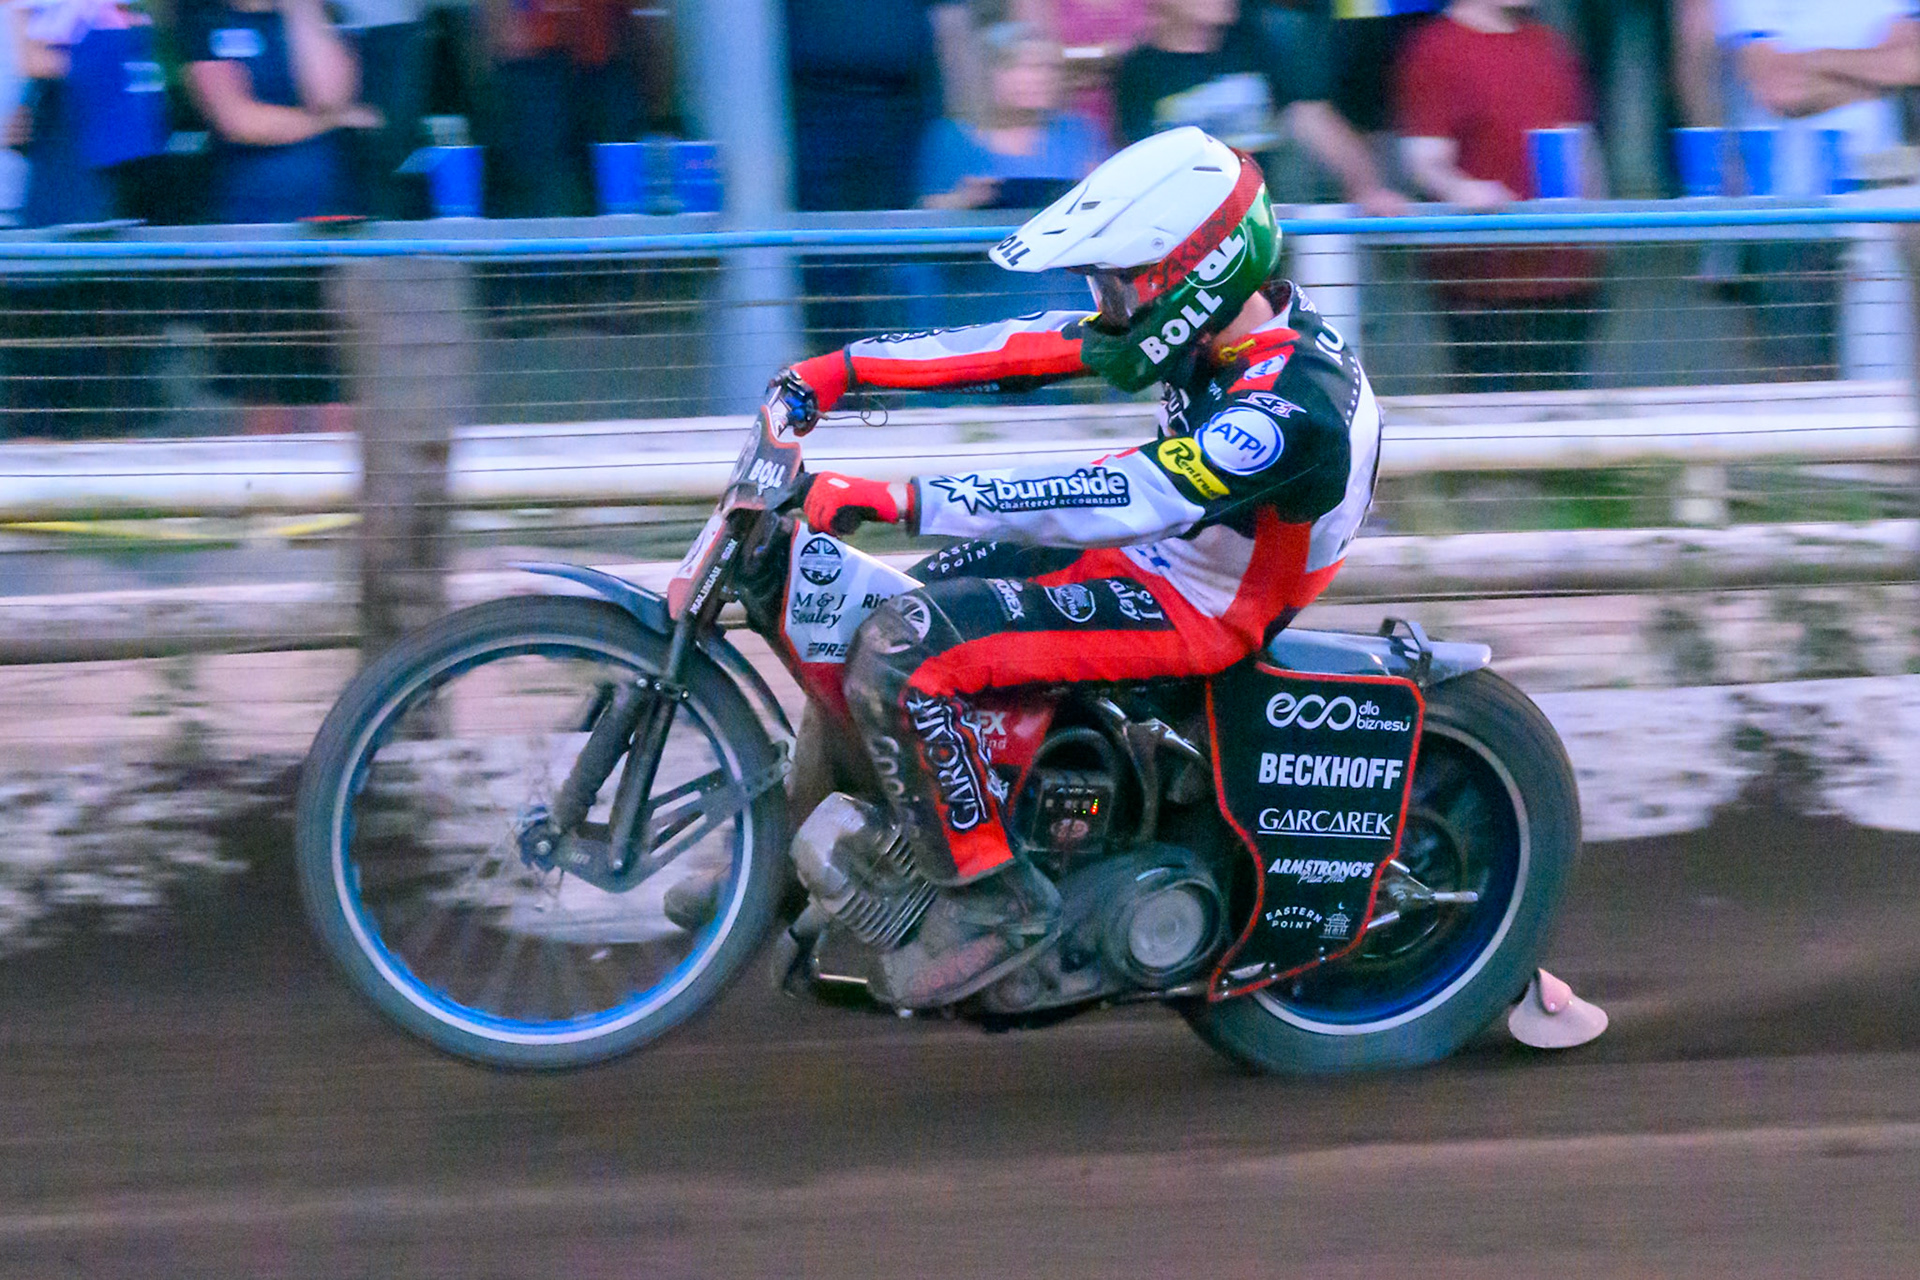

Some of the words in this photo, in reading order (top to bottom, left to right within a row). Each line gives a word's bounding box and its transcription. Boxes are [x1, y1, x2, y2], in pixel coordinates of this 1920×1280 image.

[1139, 289, 1223, 365] BOLL
[1211, 422, 1267, 460] ATPI
[748, 458, 786, 488] BOLL
[994, 468, 1126, 500] burnside
[1000, 498, 1056, 510] chartered
[1060, 496, 1128, 506] accountants
[927, 539, 980, 571] EAST
[941, 541, 998, 573] POINT
[794, 592, 813, 608] M
[817, 592, 835, 608] &
[834, 594, 848, 611] J
[1105, 579, 1141, 621] aley
[792, 607, 842, 629] Sealey
[1266, 692, 1357, 731] eco
[1356, 709, 1411, 732] biznesu
[1358, 700, 1380, 716] dla
[1258, 752, 1403, 790] BECKHOFF
[1259, 807, 1394, 835] GARCAREK
[1267, 858, 1375, 879] ARMSTRONG'S
[1265, 906, 1323, 924] EASTERN
[1272, 920, 1313, 930] POINT
